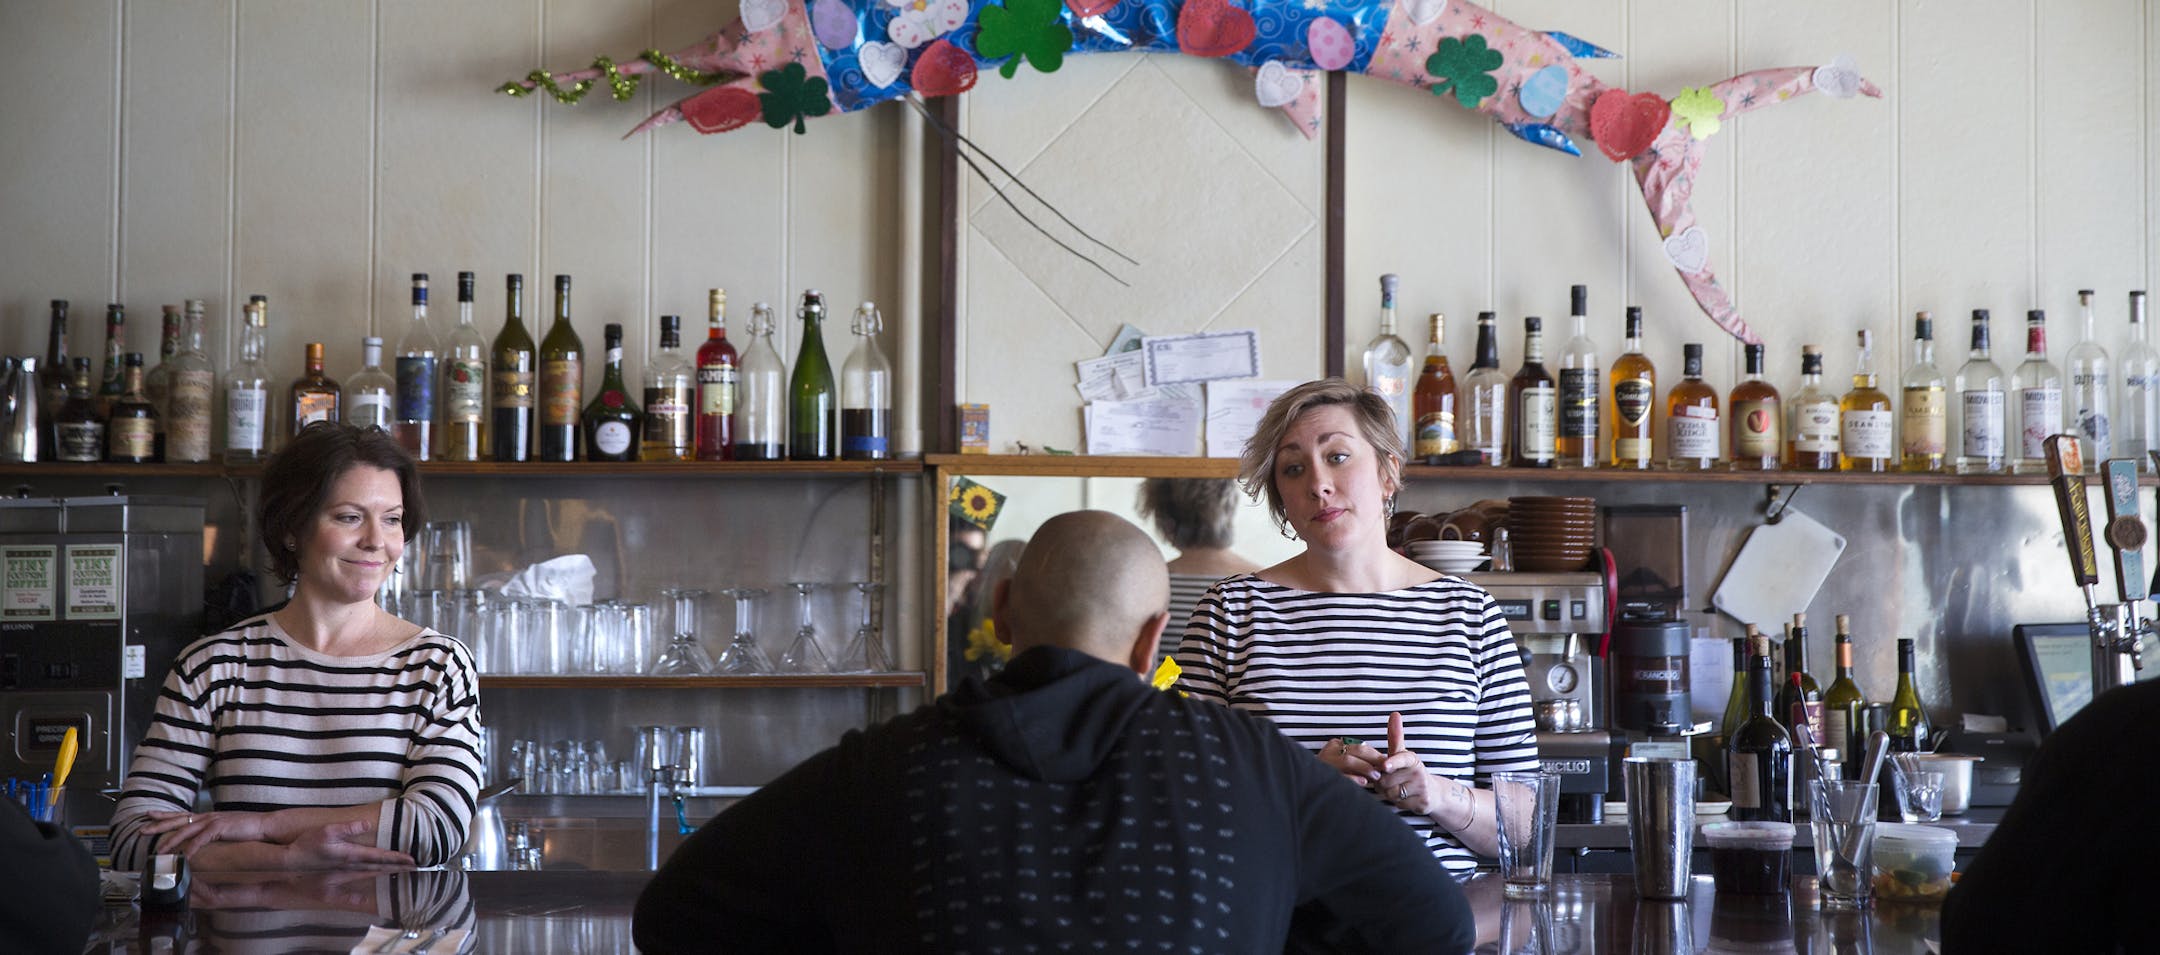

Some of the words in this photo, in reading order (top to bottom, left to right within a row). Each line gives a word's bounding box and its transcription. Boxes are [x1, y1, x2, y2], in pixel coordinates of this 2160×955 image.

[8, 558, 48, 571] TINY
[73, 558, 112, 569] TINY
[7, 580, 47, 588] COFFEE
[73, 578, 112, 586] COFFEE
[3, 623, 34, 631] BUNN
